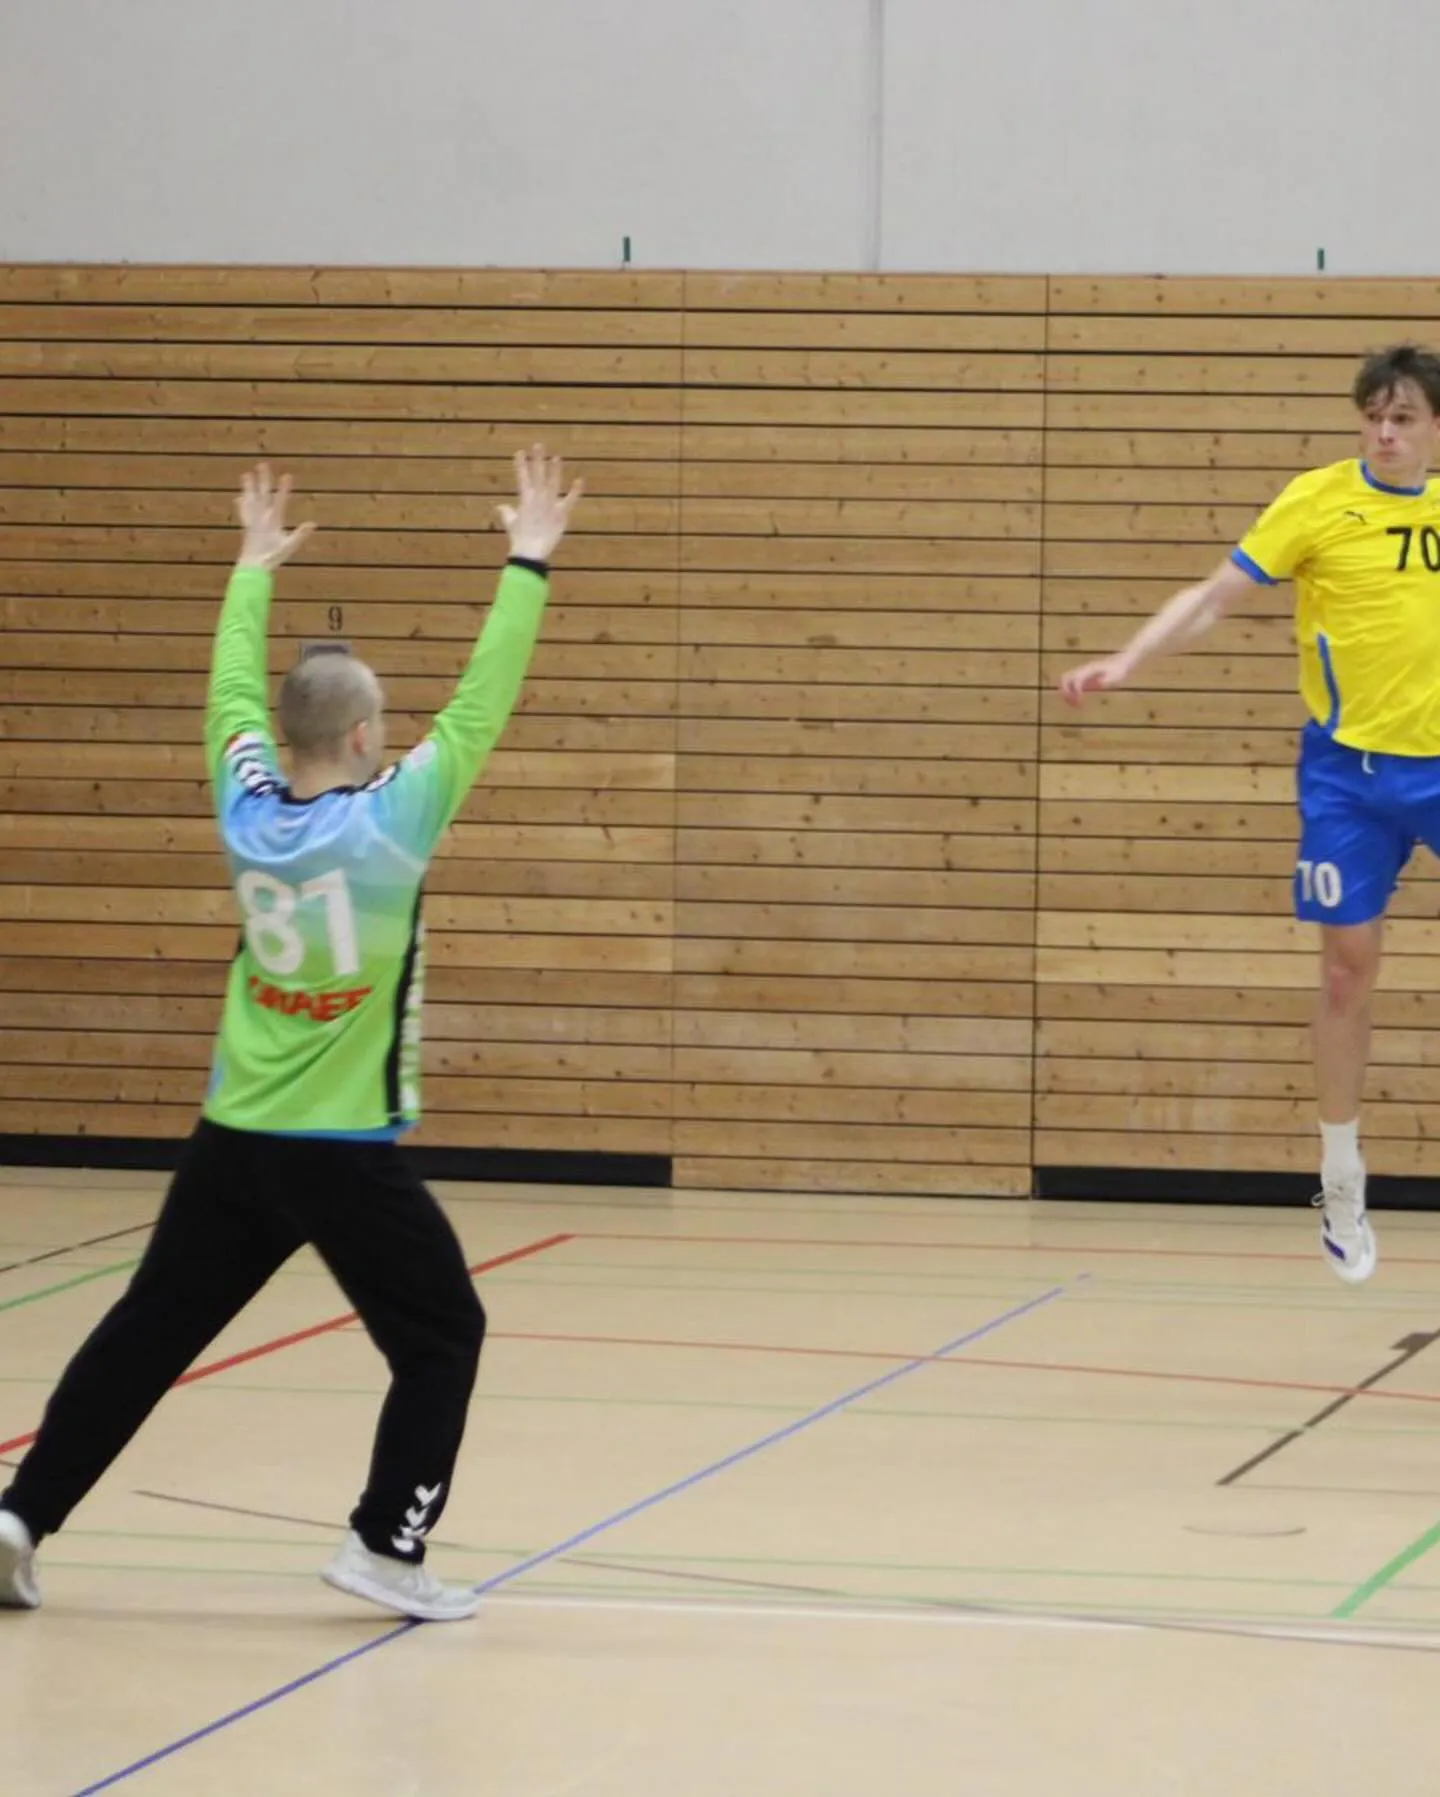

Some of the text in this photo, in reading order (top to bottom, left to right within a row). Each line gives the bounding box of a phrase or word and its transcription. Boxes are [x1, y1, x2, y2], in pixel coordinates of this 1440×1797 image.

[1386, 525, 1440, 573] 70
[327, 605, 343, 632] 9
[236, 868, 359, 976] 81
